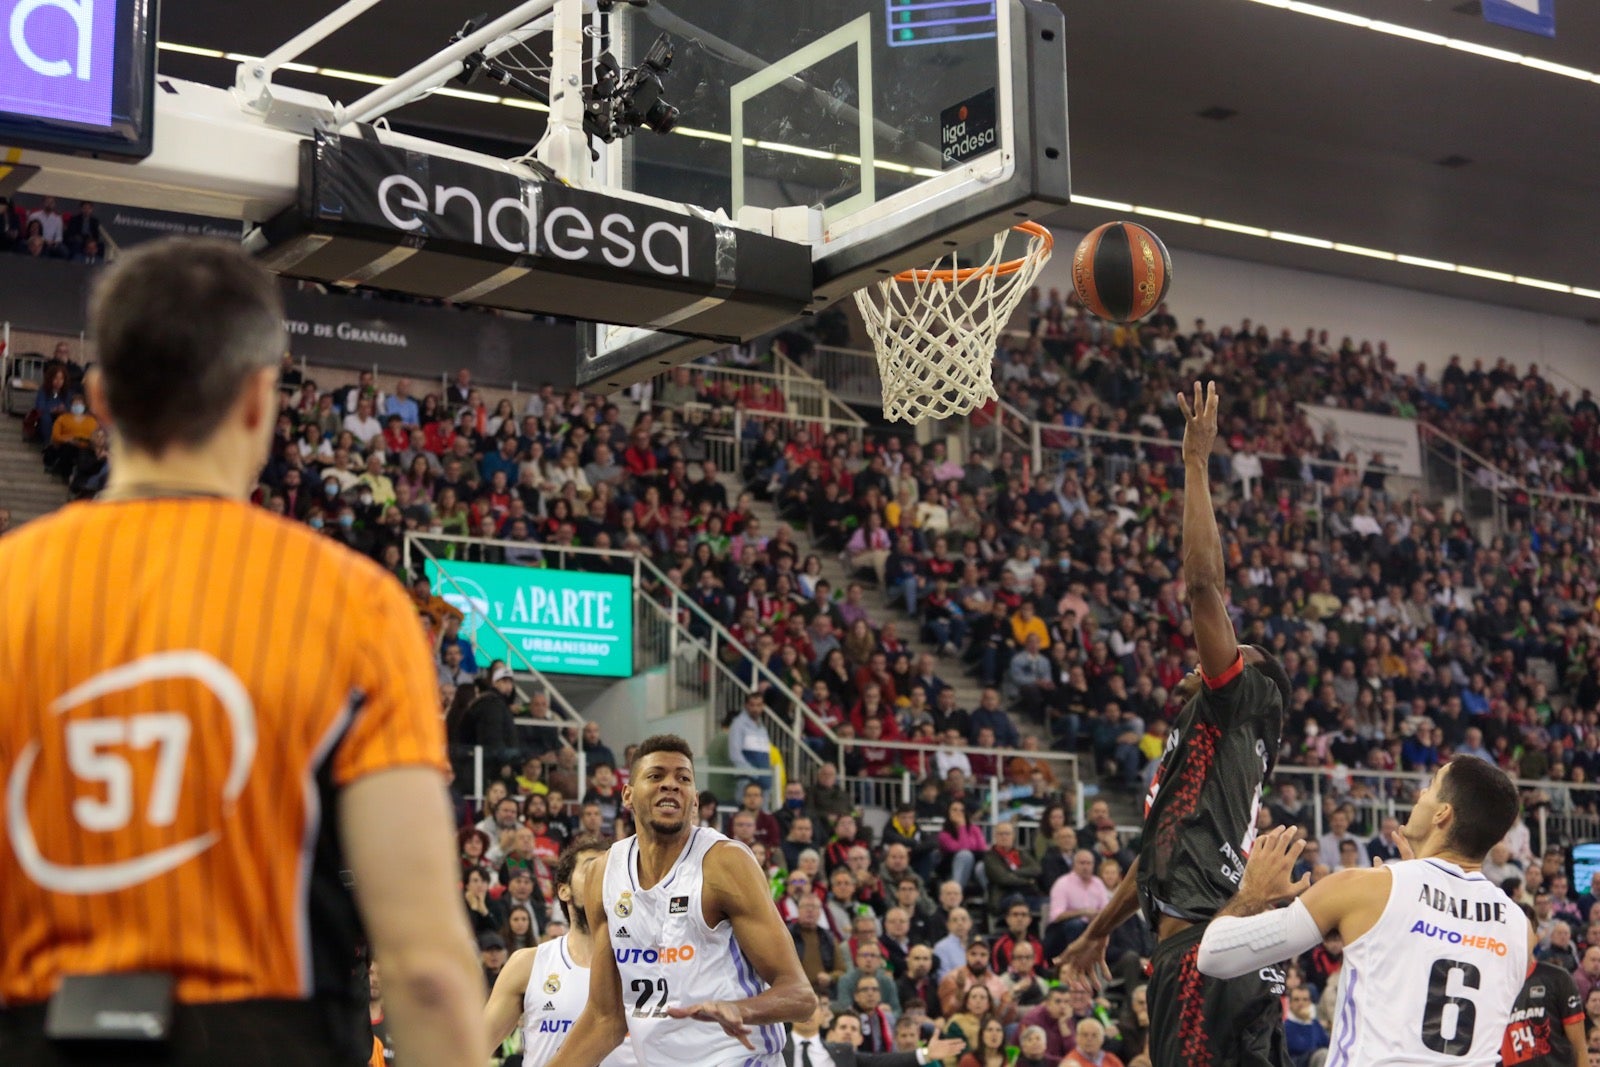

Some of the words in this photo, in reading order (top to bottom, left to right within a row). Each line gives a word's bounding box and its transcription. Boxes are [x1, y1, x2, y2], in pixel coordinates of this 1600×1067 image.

[942, 121, 966, 144] liga
[943, 127, 994, 162] endesa
[377, 174, 690, 278] endesa
[313, 323, 334, 338] DE
[336, 321, 408, 348] GRANADA
[510, 585, 615, 629] APARTE
[522, 637, 611, 656] URBANISMO
[66, 711, 191, 832] 57
[1418, 883, 1507, 924] ABALDE
[1410, 919, 1508, 956] AUTOHERO
[631, 978, 669, 1019] 22
[1421, 958, 1481, 1057] 6
[540, 1020, 576, 1033] AUT
[1510, 1025, 1536, 1053] 24
